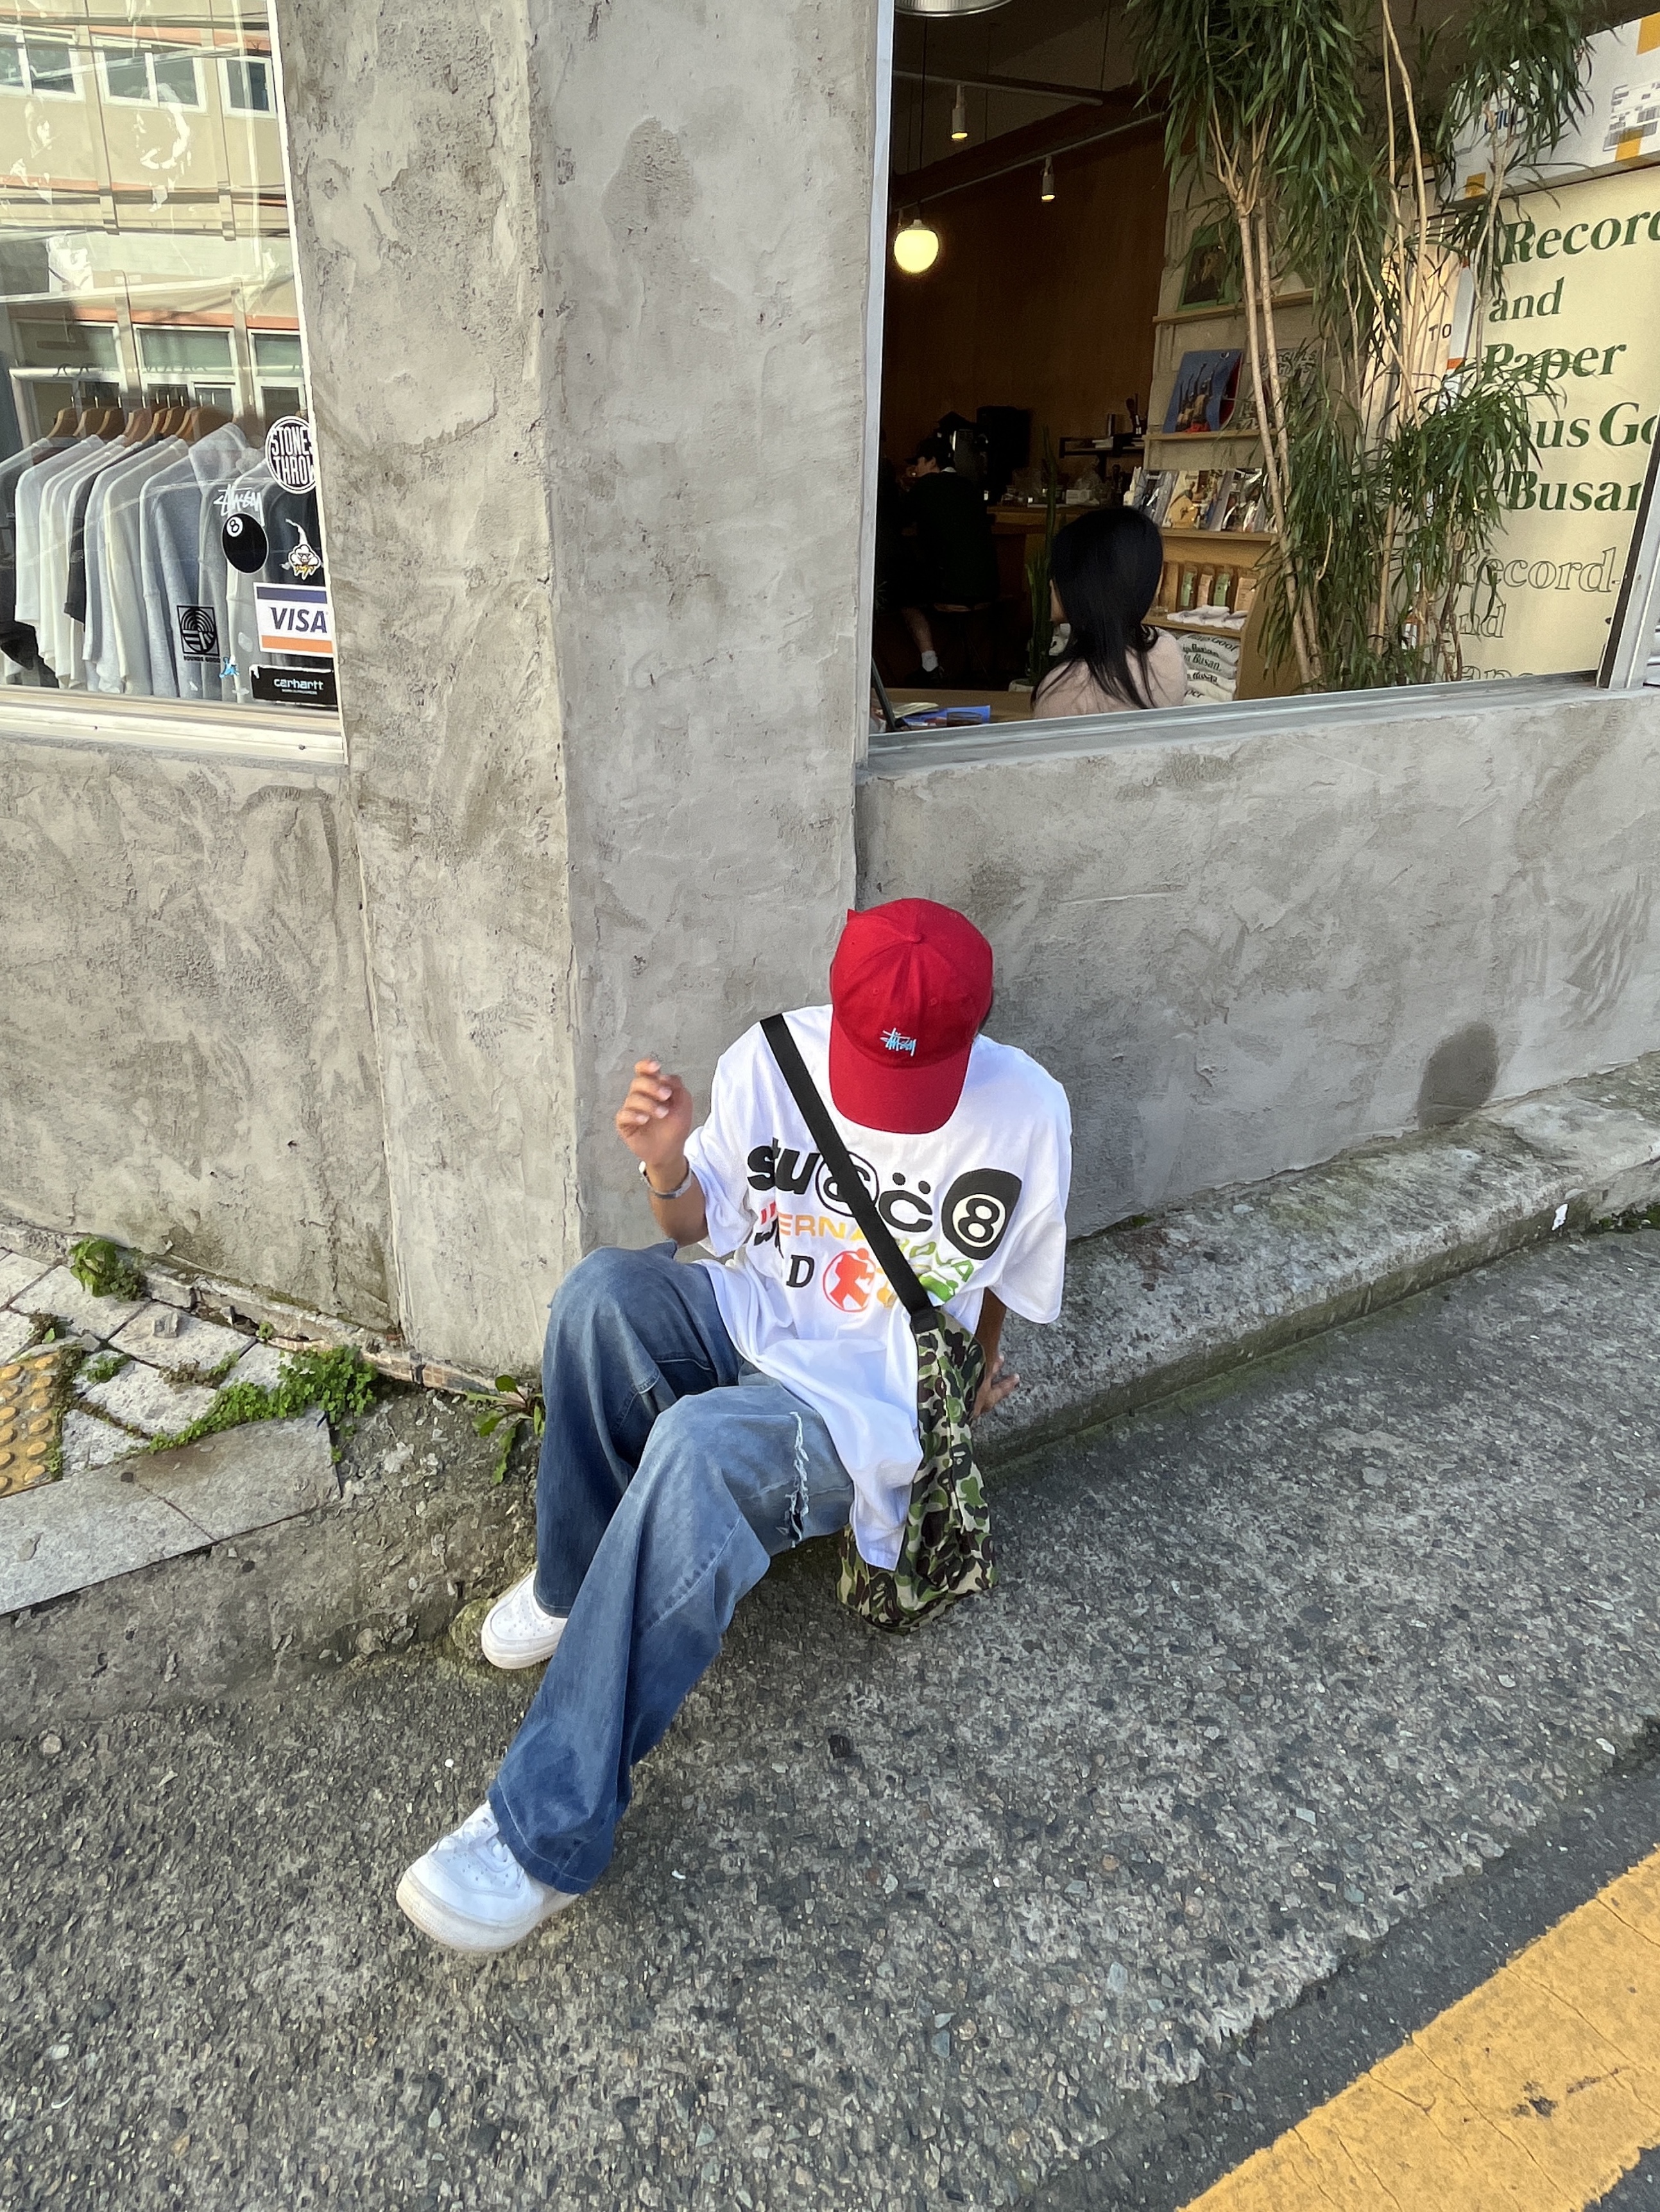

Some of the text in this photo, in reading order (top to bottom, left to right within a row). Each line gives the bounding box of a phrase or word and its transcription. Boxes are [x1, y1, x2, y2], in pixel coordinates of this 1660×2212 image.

[1489, 276, 1564, 322] and
[1482, 343, 1627, 393] Paper
[268, 607, 328, 633] VISA
[273, 678, 324, 690] carhartt
